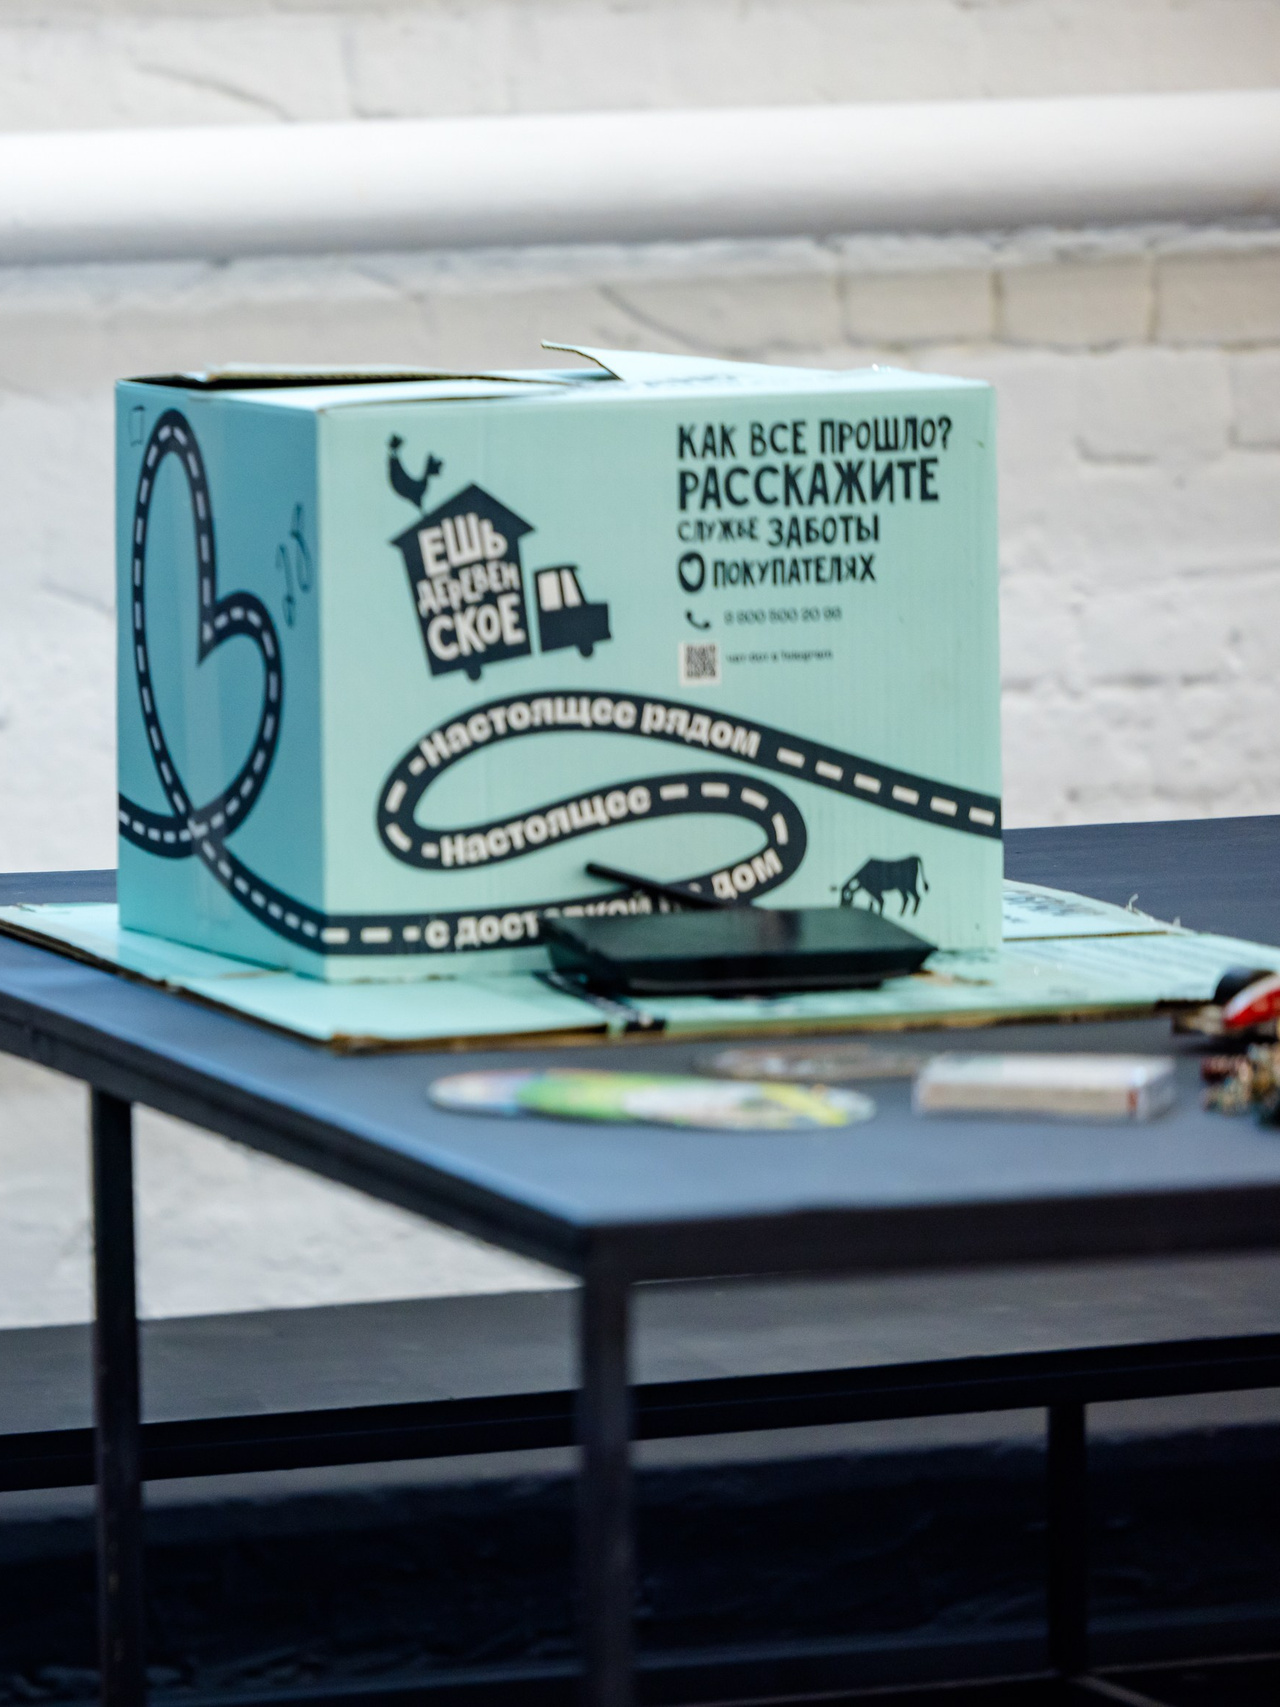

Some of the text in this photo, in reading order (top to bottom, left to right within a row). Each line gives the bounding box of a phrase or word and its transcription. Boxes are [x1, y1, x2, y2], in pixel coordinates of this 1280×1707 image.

[677, 414, 953, 460] КАК ВСЕ ПРОШЛО?
[677, 456, 940, 512] РАССКАЖИТЕ
[417, 511, 508, 577] ЕШЬ
[677, 513, 880, 549] СЛУЖБЕ ЗАБОТЫ
[712, 552, 876, 588] ПОКУПАТЕЛЯХ
[426, 592, 527, 662] СКОЕ
[420, 695, 763, 769] Настоящее рядом
[438, 785, 652, 868] Настоящее
[710, 848, 784, 900] дом
